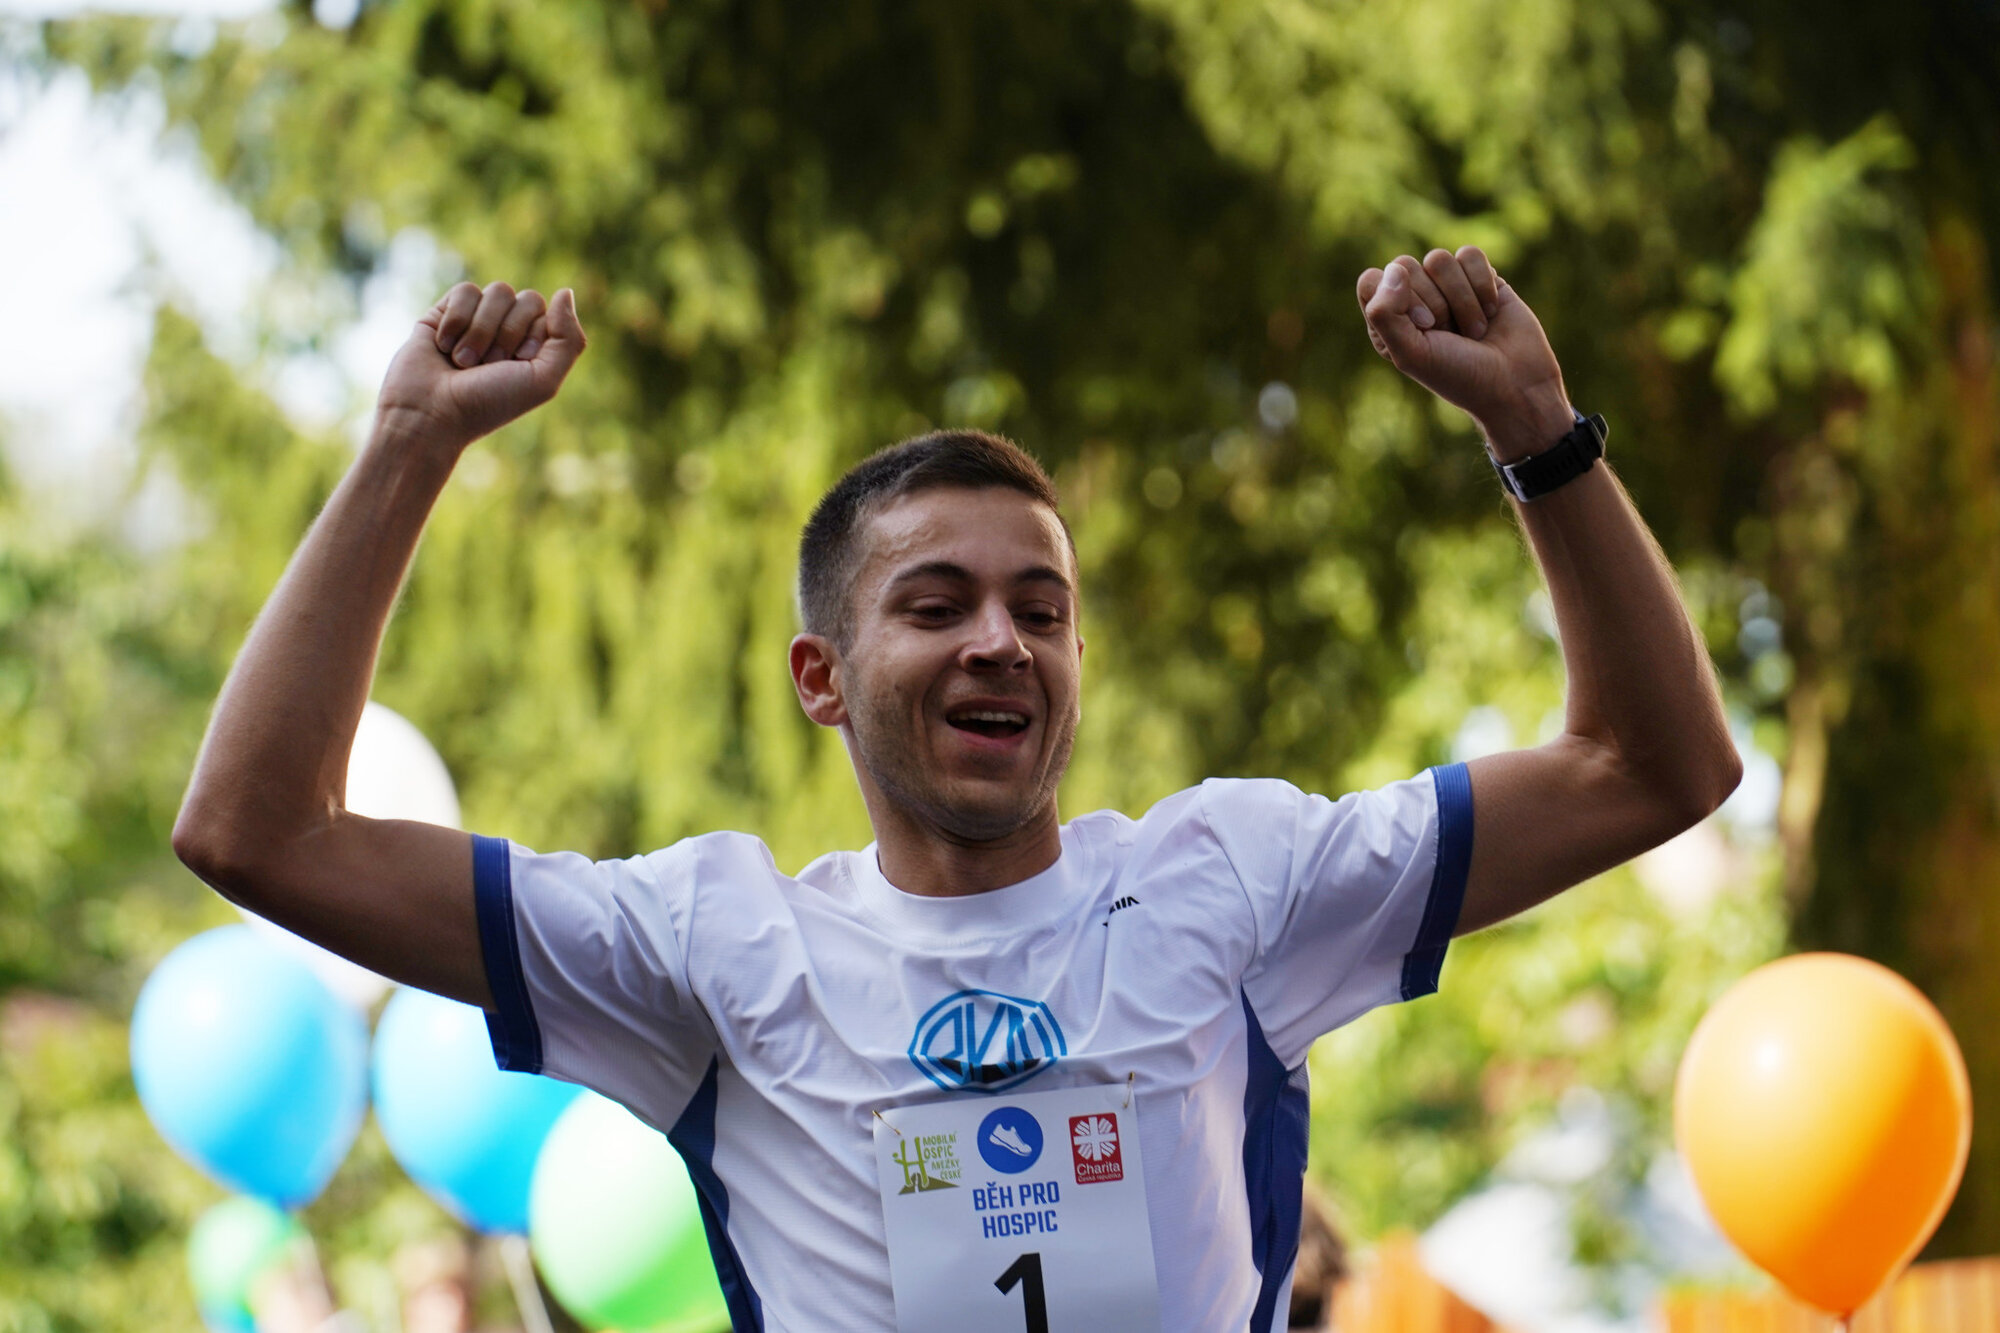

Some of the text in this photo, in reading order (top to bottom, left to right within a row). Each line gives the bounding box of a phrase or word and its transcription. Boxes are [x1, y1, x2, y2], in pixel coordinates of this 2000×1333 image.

[1077, 1161, 1120, 1176] Charita
[972, 1181, 1060, 1211] BĚH PRO
[982, 1210, 1058, 1239] HOSPIC
[994, 1252, 1049, 1333] 1
